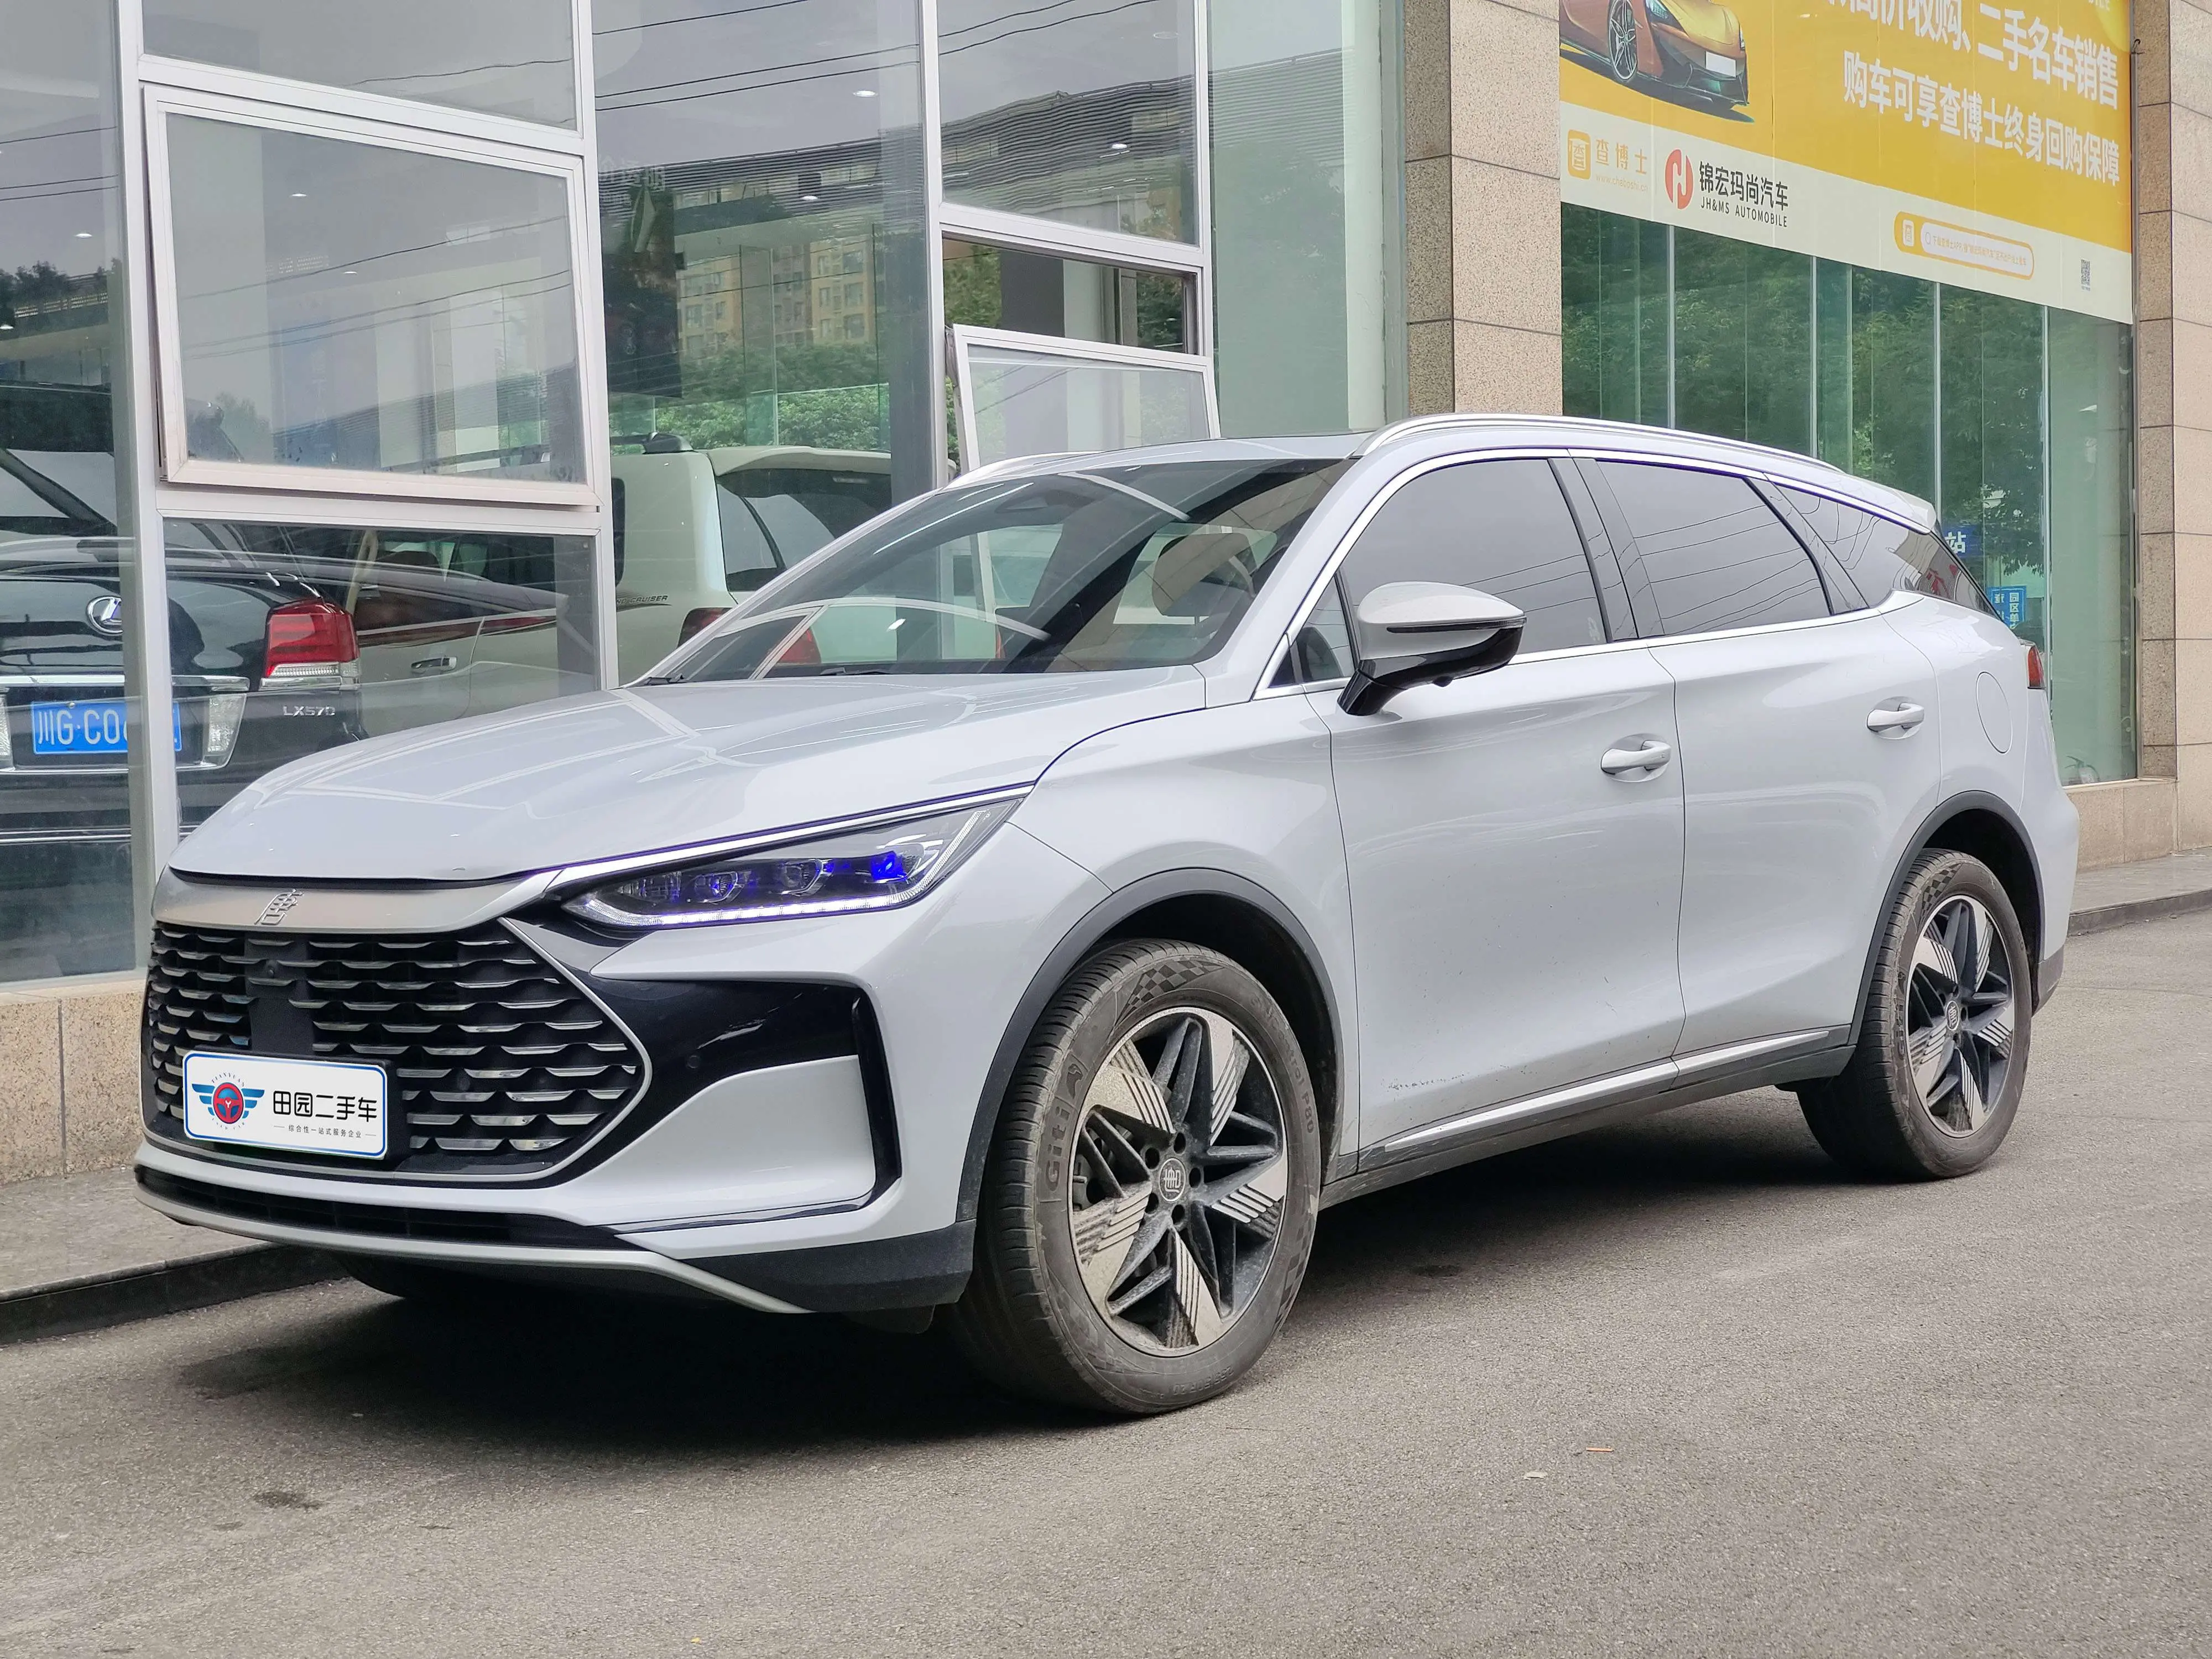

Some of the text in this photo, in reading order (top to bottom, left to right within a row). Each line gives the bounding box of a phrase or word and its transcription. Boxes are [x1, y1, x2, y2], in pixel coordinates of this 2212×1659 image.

[1844, 51, 2120, 186] 购车可享查博士终身回购保障
[1596, 139, 1647, 175] 查博士
[1699, 160, 1788, 211] 锦宏玛尚汽车
[1700, 196, 1788, 228] JH&MS AUTOMOBILE
[1944, 531, 1966, 553] 站
[629, 595, 668, 603] CRUISER
[273, 1090, 378, 1123] 田园二手车
[288, 1124, 362, 1138] 综合性一站式服务企业
[1045, 1105, 1071, 1192] Giti
